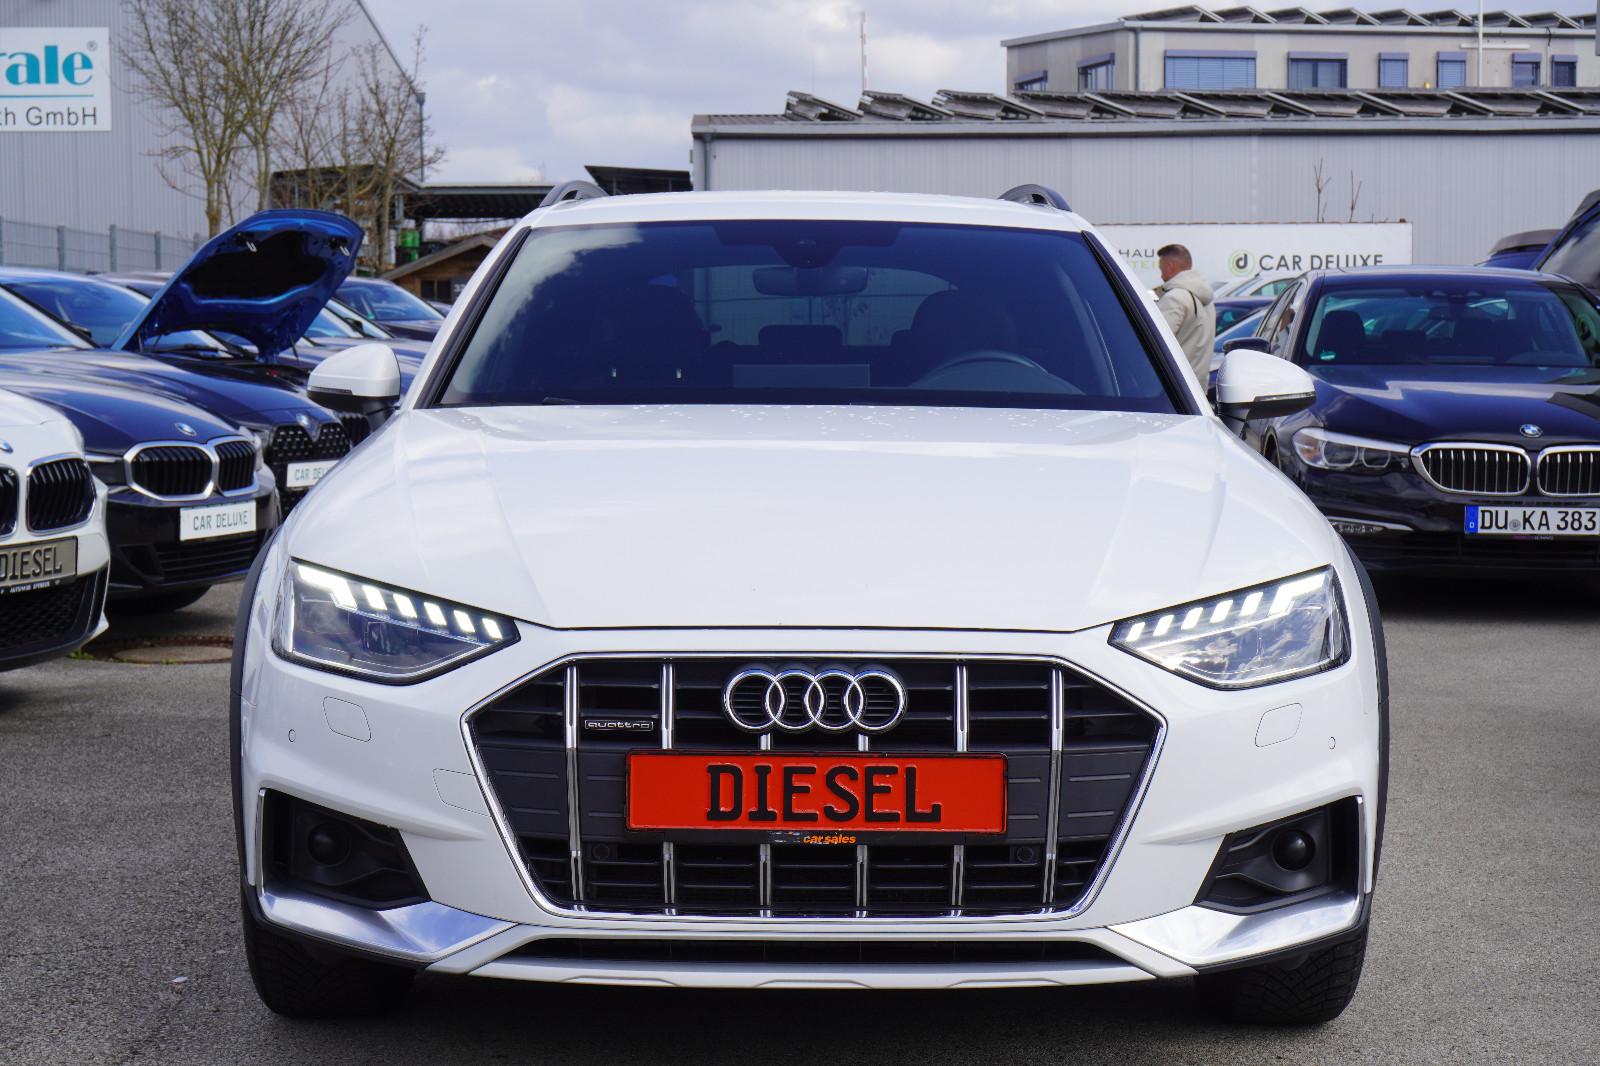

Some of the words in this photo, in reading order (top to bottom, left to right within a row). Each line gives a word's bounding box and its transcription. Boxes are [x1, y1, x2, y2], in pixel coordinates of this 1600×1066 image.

[26, 106, 97, 126] GmbH
[1259, 254, 1302, 271] CAR
[1310, 254, 1384, 270] DELUXE
[193, 515, 212, 531] CAR
[216, 510, 249, 529] DELUXE
[1480, 509, 1509, 531] DU
[1522, 510, 1551, 531] KA
[1556, 510, 1597, 531] 383
[0, 546, 63, 581] DIESEL
[587, 721, 650, 729] quattro
[706, 764, 942, 822] DIESEL
